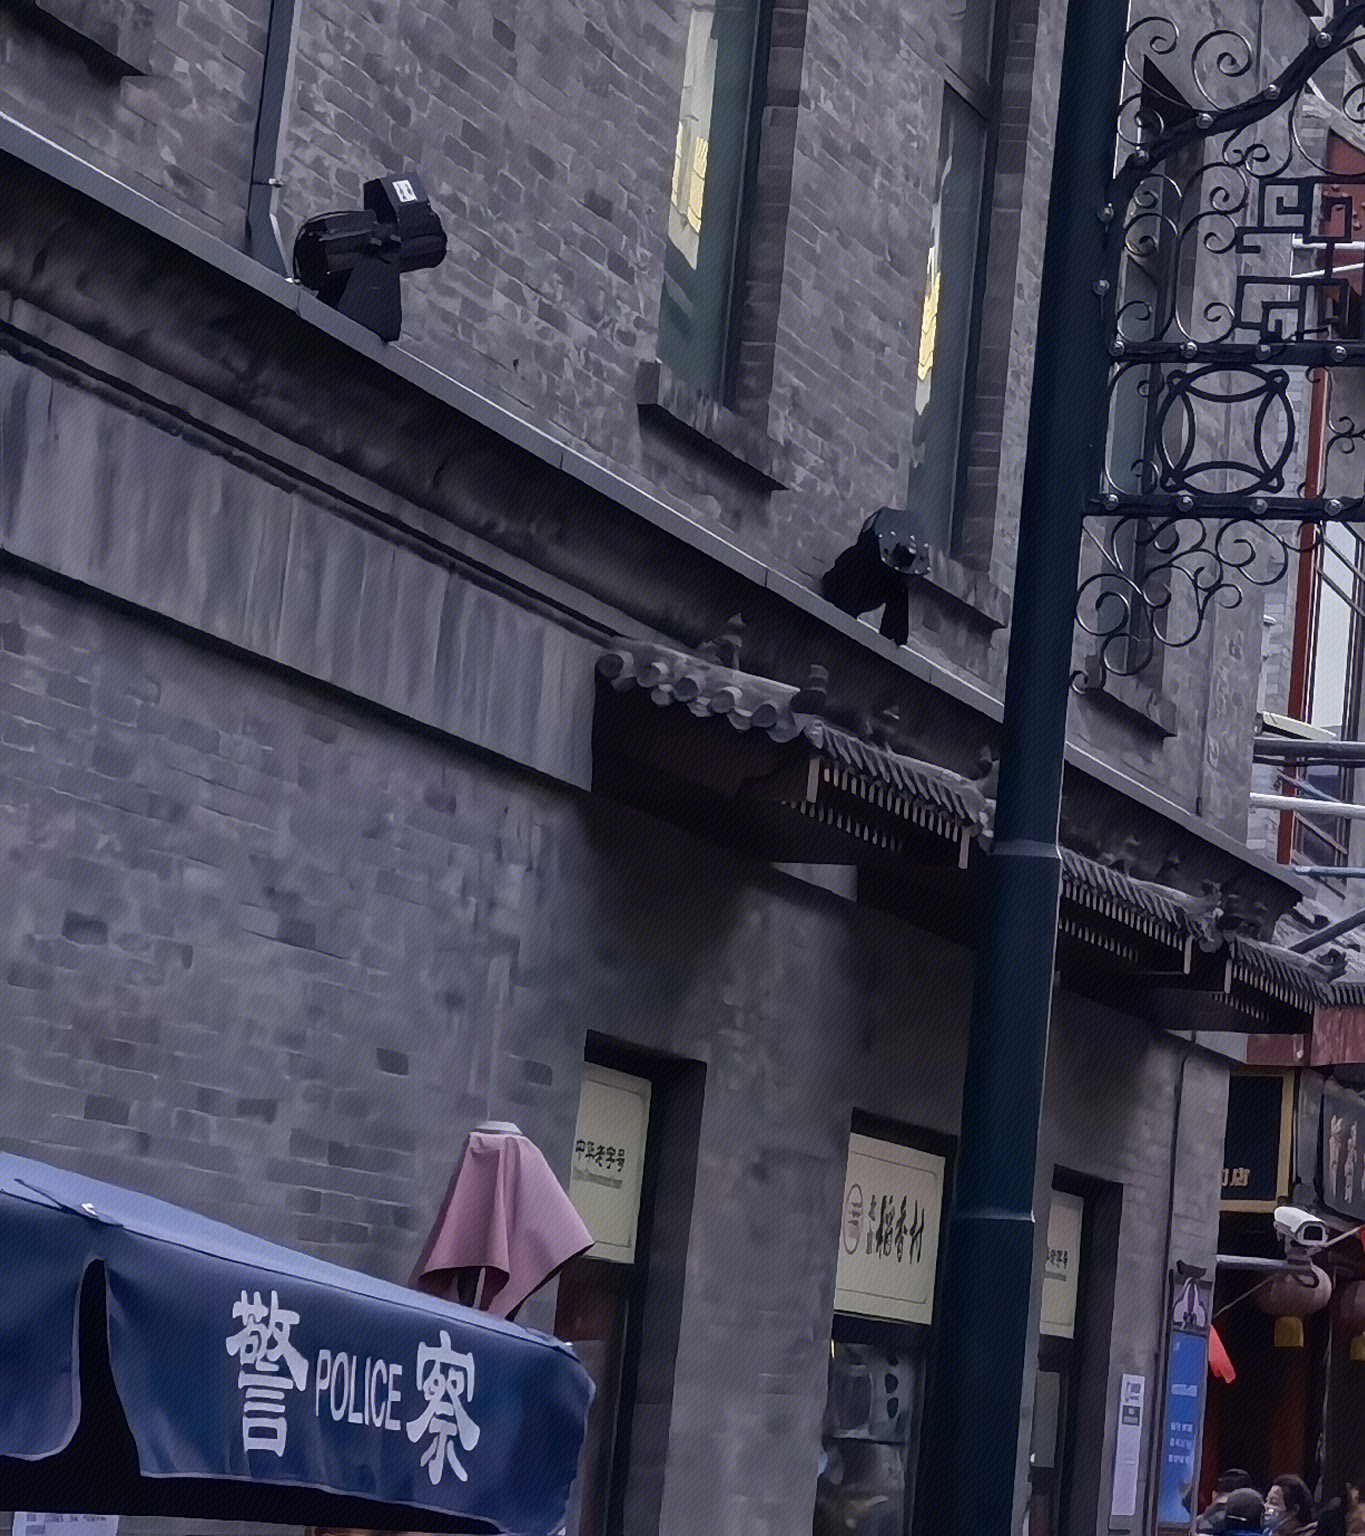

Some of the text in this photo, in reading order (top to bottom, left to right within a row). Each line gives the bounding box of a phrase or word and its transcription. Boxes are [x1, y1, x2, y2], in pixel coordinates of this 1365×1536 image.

[226, 1289, 481, 1486] 警 POLICE 察
